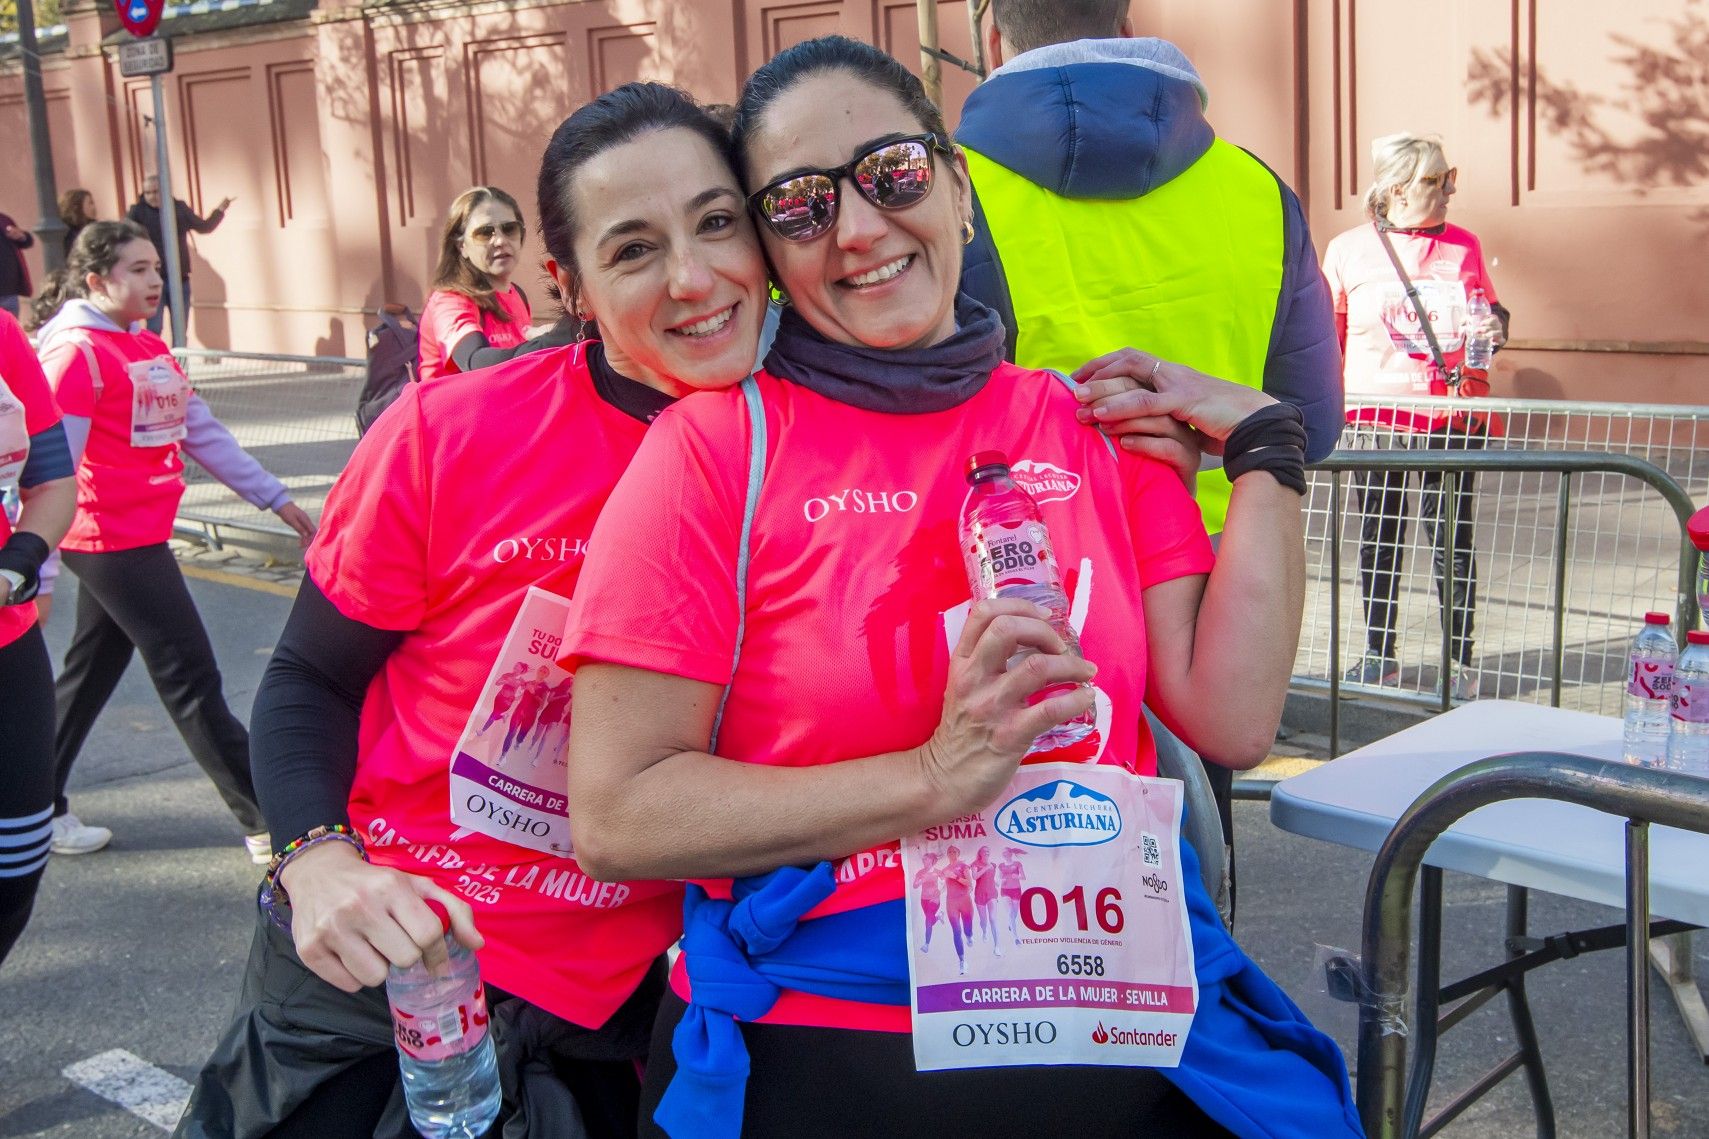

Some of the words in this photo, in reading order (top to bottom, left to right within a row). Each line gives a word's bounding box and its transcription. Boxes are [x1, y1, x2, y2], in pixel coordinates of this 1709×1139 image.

[1407, 310, 1438, 323] 06
[1015, 479, 1077, 495] TURIANA
[803, 488, 918, 523] OYSHO
[493, 537, 589, 563] OYSH
[984, 541, 1033, 561] ERO
[533, 628, 547, 640] TU
[528, 639, 559, 661] SU
[488, 775, 544, 806] CARRERA
[546, 797, 564, 811] DE
[466, 794, 551, 837] OYSHO
[1025, 802, 1071, 813] CENTRAL
[924, 823, 987, 841] SUMA
[1005, 809, 1117, 834] ASTURIANA
[453, 875, 504, 905] 2025
[503, 865, 540, 890] LA
[538, 868, 631, 909] MUJER
[1019, 885, 1125, 934] 016
[1060, 937, 1092, 945] VIOLENCIA
[1056, 954, 1105, 977] 6558
[961, 988, 1031, 1004] CARRERA
[1036, 986, 1055, 1001] DE
[1059, 986, 1077, 1001] LA
[1080, 986, 1118, 1003] MUJER
[1126, 989, 1168, 1006] SEVILLA
[953, 1021, 1057, 1047] OYSHO
[1111, 1026, 1177, 1047] Santander
